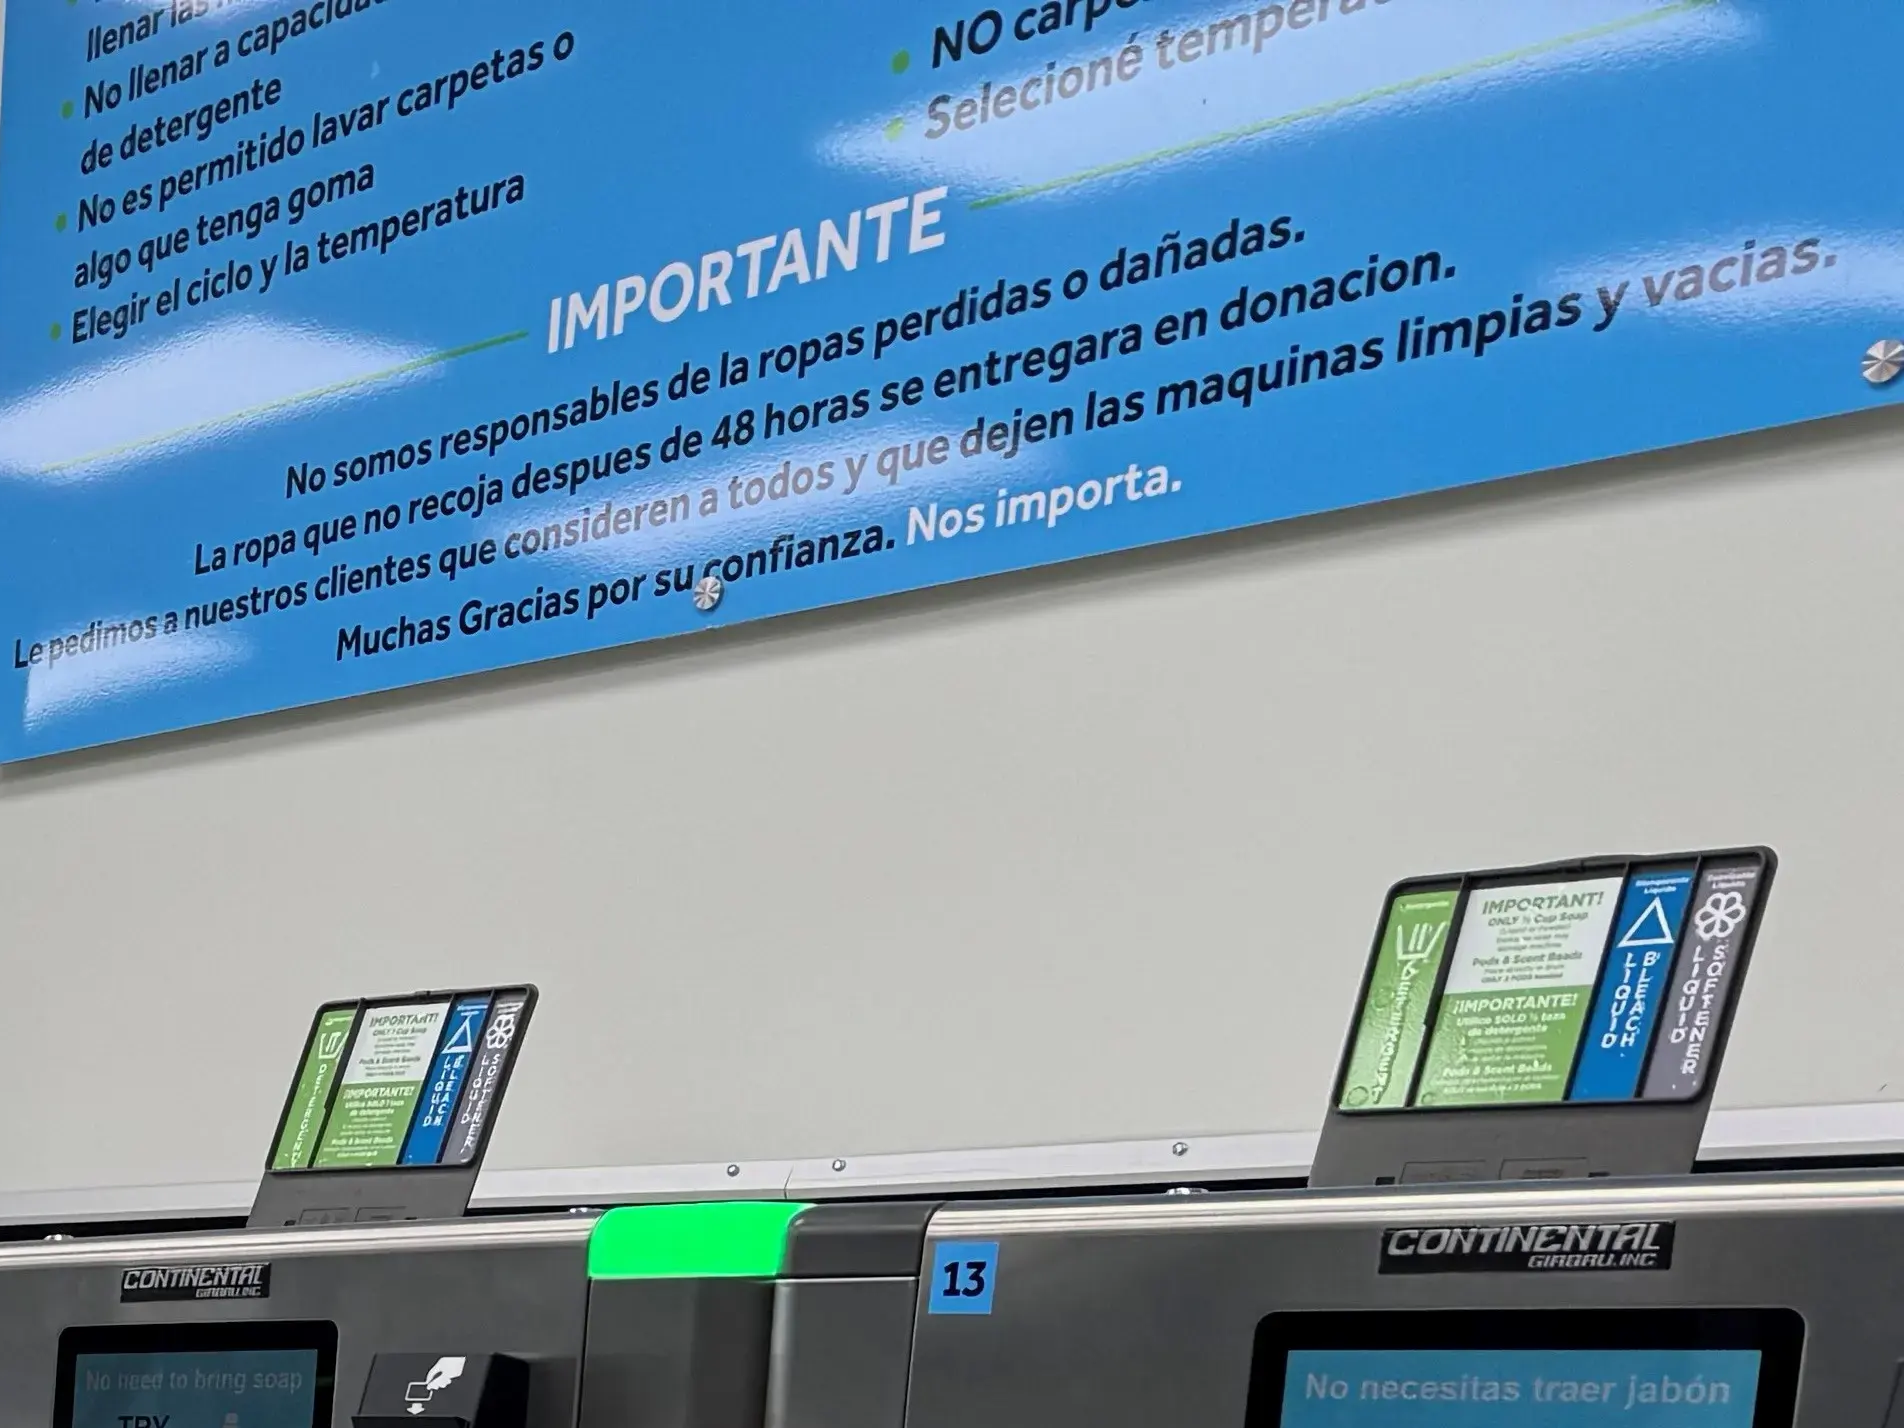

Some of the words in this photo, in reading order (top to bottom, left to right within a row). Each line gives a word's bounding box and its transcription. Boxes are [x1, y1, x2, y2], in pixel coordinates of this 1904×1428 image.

[84, 84, 122, 119] No
[129, 47, 209, 101] llenar
[214, 40, 230, 67] a
[238, 0, 387, 57] capacid
[86, 9, 165, 62] llenar
[931, 10, 1003, 69] NO
[77, 195, 115, 233] No
[122, 183, 152, 216] es
[160, 126, 305, 204] permitido
[312, 97, 391, 148] lavar
[396, 38, 544, 118] carpetas
[553, 30, 574, 60] o
[80, 139, 113, 175] de
[120, 78, 281, 160] detergente
[923, 32, 1144, 140] Selecioné
[72, 292, 149, 344] Elegir
[156, 277, 180, 315] el
[186, 257, 252, 307] ciclo
[259, 256, 279, 293] y
[285, 242, 310, 275] la
[317, 172, 525, 264] temperatura
[74, 249, 131, 288] algo
[138, 229, 189, 274] que
[196, 196, 280, 250] tenga
[288, 164, 374, 224] goma
[547, 186, 949, 354] IMPORTANTE
[285, 462, 326, 498] No
[333, 437, 432, 487] somos
[438, 378, 659, 462] responsables
[667, 361, 711, 401] de
[719, 352, 750, 388] la
[758, 323, 866, 381] ropas
[873, 277, 1052, 359] perdidas
[1062, 268, 1088, 300] o
[1099, 214, 1306, 291] dañadas.
[14, 637, 43, 670] Le
[48, 611, 158, 671] pedimos
[164, 610, 178, 634] a
[185, 580, 307, 630] nuestros
[314, 555, 431, 602] clientes
[438, 536, 497, 581] que
[504, 493, 690, 559] consideren
[699, 487, 719, 518] a
[728, 458, 835, 509] todos
[843, 453, 868, 495] y
[876, 431, 950, 483] que
[959, 403, 1074, 460] dejen
[1085, 386, 1145, 432] las
[1156, 331, 1385, 416] maquinas
[1396, 291, 1582, 362] limpias
[1592, 279, 1630, 332] y
[1641, 234, 1839, 308] vacias.
[194, 543, 226, 574] La
[232, 529, 296, 569] ropa
[303, 511, 357, 552] que
[364, 501, 400, 535] no
[408, 475, 503, 523] recoja
[511, 440, 652, 497] despues
[660, 424, 702, 464] de
[712, 409, 754, 450] 48
[764, 388, 870, 439] horas
[880, 375, 924, 411] se
[933, 322, 1142, 399] entregara
[1153, 306, 1208, 347] en
[1219, 250, 1456, 330] donacion.
[336, 616, 451, 661] Muchas
[458, 584, 580, 637] Gracias
[588, 573, 646, 619] por
[654, 566, 694, 594] su
[703, 524, 896, 586] confianza.
[906, 502, 985, 546] Nos
[995, 462, 1182, 529] importa.
[1482, 891, 1605, 915] IMPORTANT!
[1453, 993, 1579, 1015] ¡IMPORTANTE!
[1601, 952, 1637, 1049] LIQUID
[1620, 950, 1659, 1048] BLEACH
[1670, 944, 1705, 1044] LIQUID
[123, 1264, 263, 1290] CONTINENTAL
[943, 1261, 988, 1297] 13
[1387, 1223, 1661, 1256] CONTINENTAL
[86, 1369, 111, 1392] No
[117, 1368, 162, 1391] need
[169, 1372, 189, 1390] to
[194, 1368, 247, 1394] bring
[252, 1371, 303, 1395] soap
[1305, 1373, 1348, 1400] No
[1359, 1374, 1521, 1402] necesitas
[1532, 1376, 1617, 1403] traer
[1623, 1373, 1731, 1411] jabón
